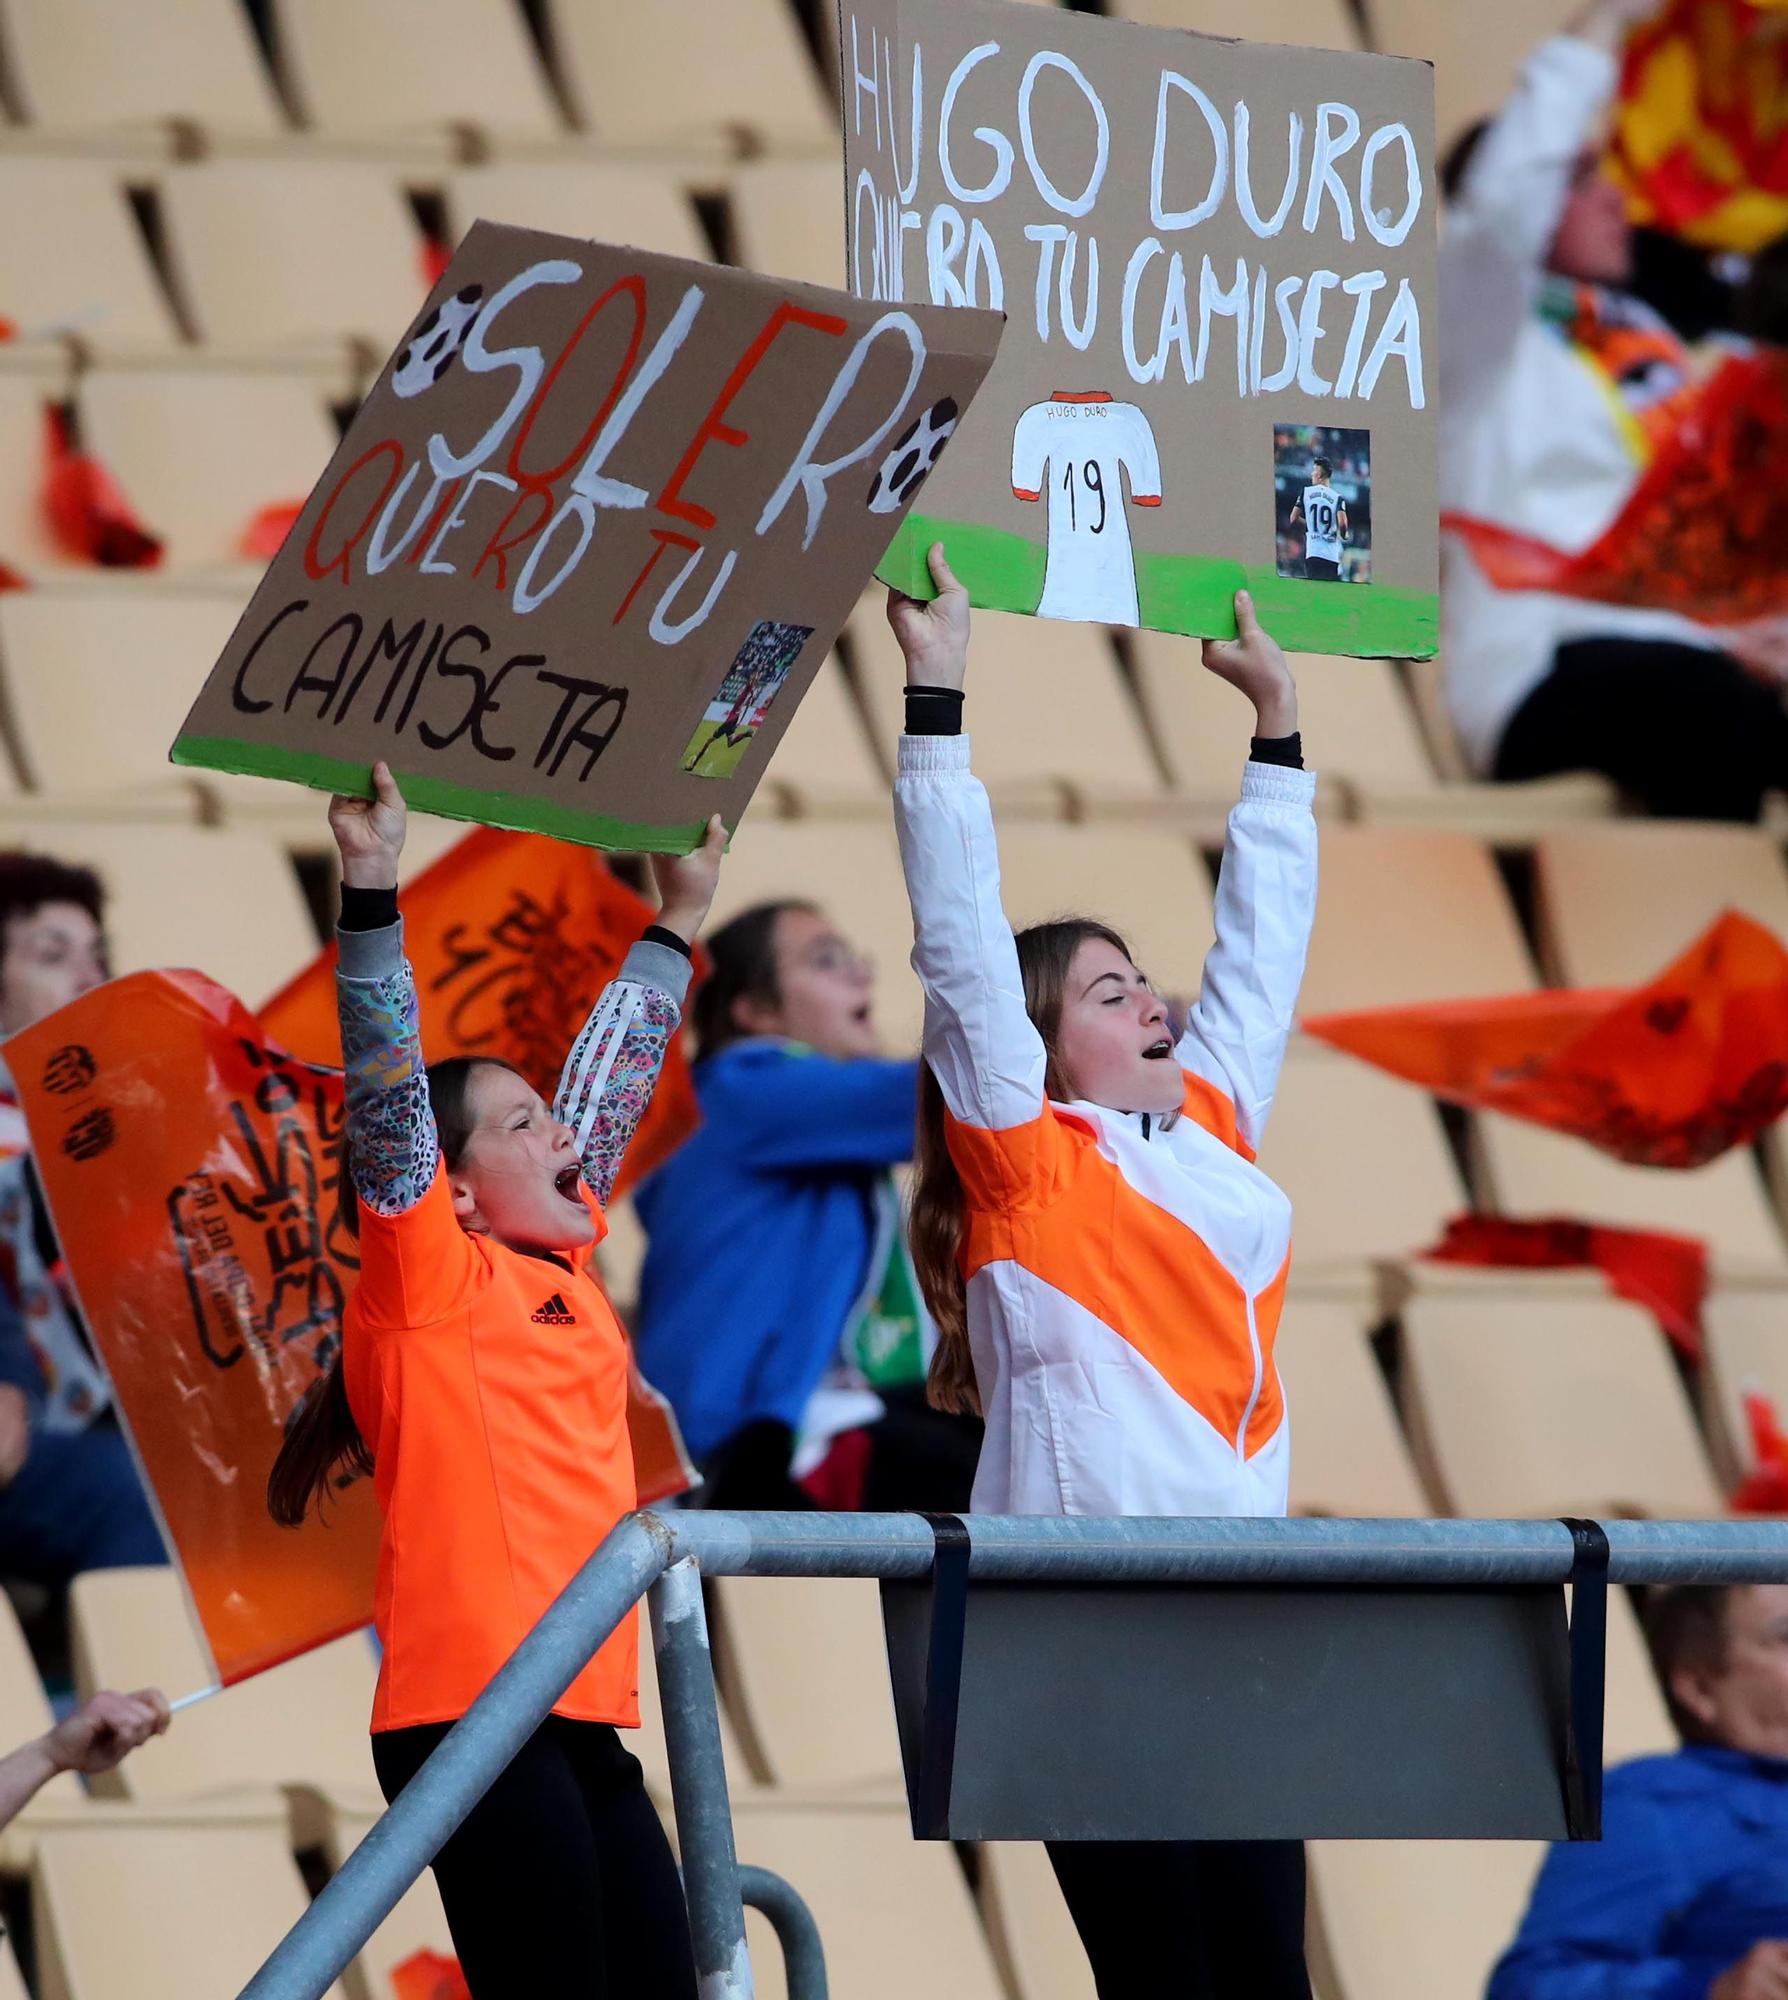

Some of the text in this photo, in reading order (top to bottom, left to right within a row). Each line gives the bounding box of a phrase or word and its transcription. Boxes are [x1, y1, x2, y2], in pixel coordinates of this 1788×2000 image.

[851, 13, 1422, 248] HUGO DURO
[428, 259, 927, 551] SOLER
[1024, 224, 1097, 350] TU
[1121, 237, 1425, 410] CAMISETA
[1046, 406, 1107, 419] HUGO DURO
[1063, 459, 1105, 534] 19
[303, 439, 737, 645] QUIERO TU
[1310, 503, 1332, 535] 19
[232, 599, 628, 782] CAMISETA
[531, 1313, 576, 1325] adidas
